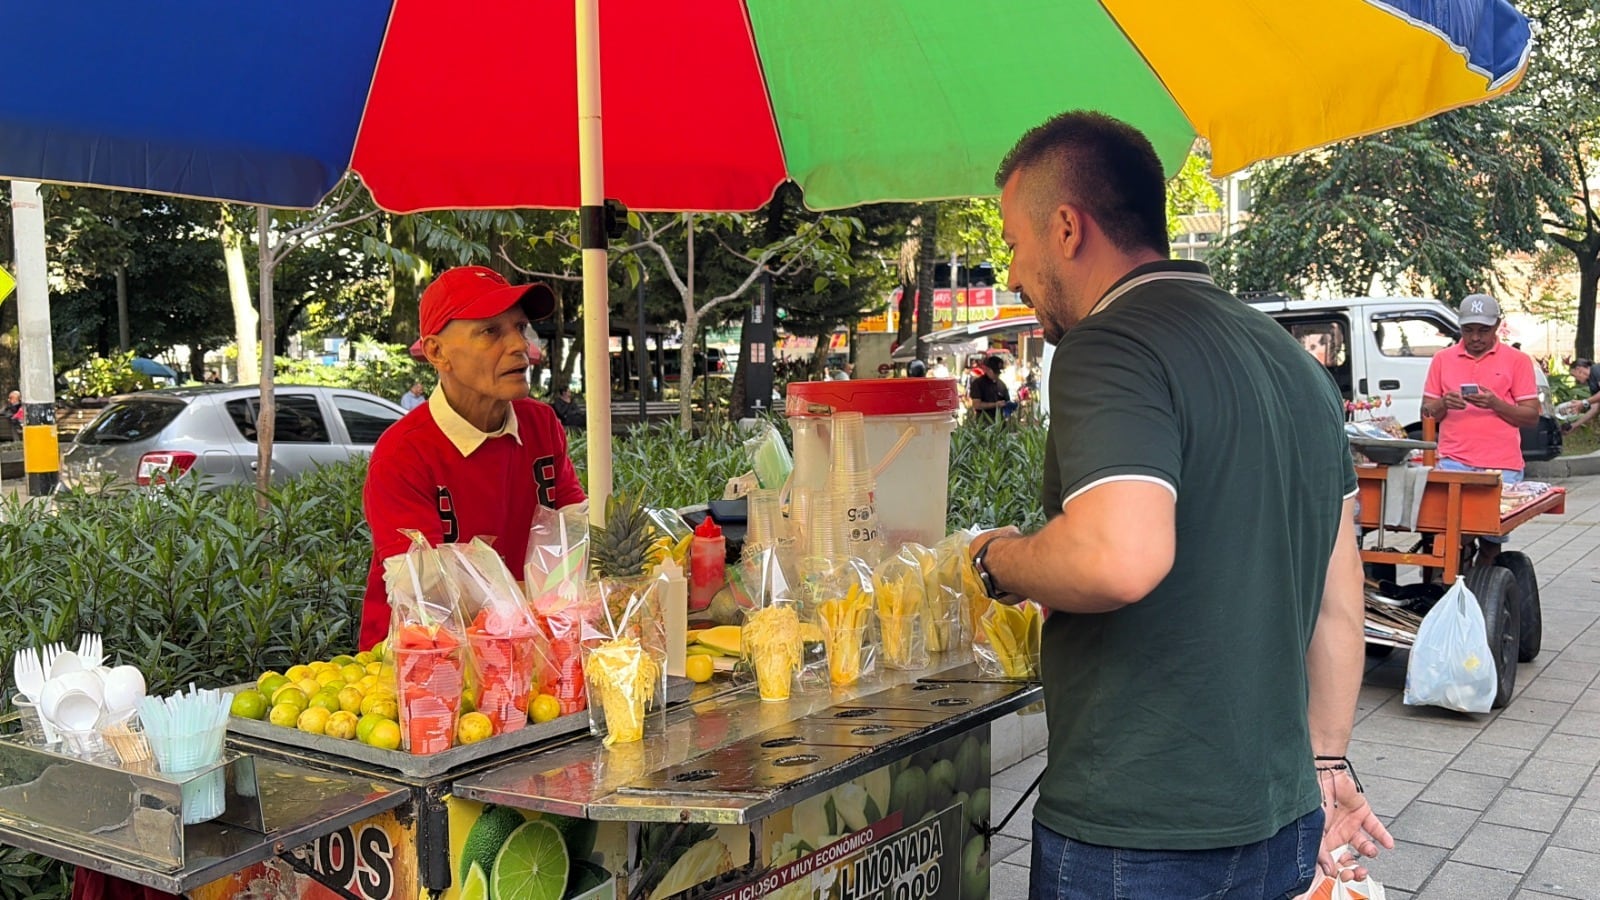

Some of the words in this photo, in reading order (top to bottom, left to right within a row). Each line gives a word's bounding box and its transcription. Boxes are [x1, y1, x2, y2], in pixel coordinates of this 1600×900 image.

[1471, 300, 1484, 313] NY
[781, 868, 789, 883] Y
[791, 857, 813, 880] MUY
[841, 820, 943, 900] LIMONADA
